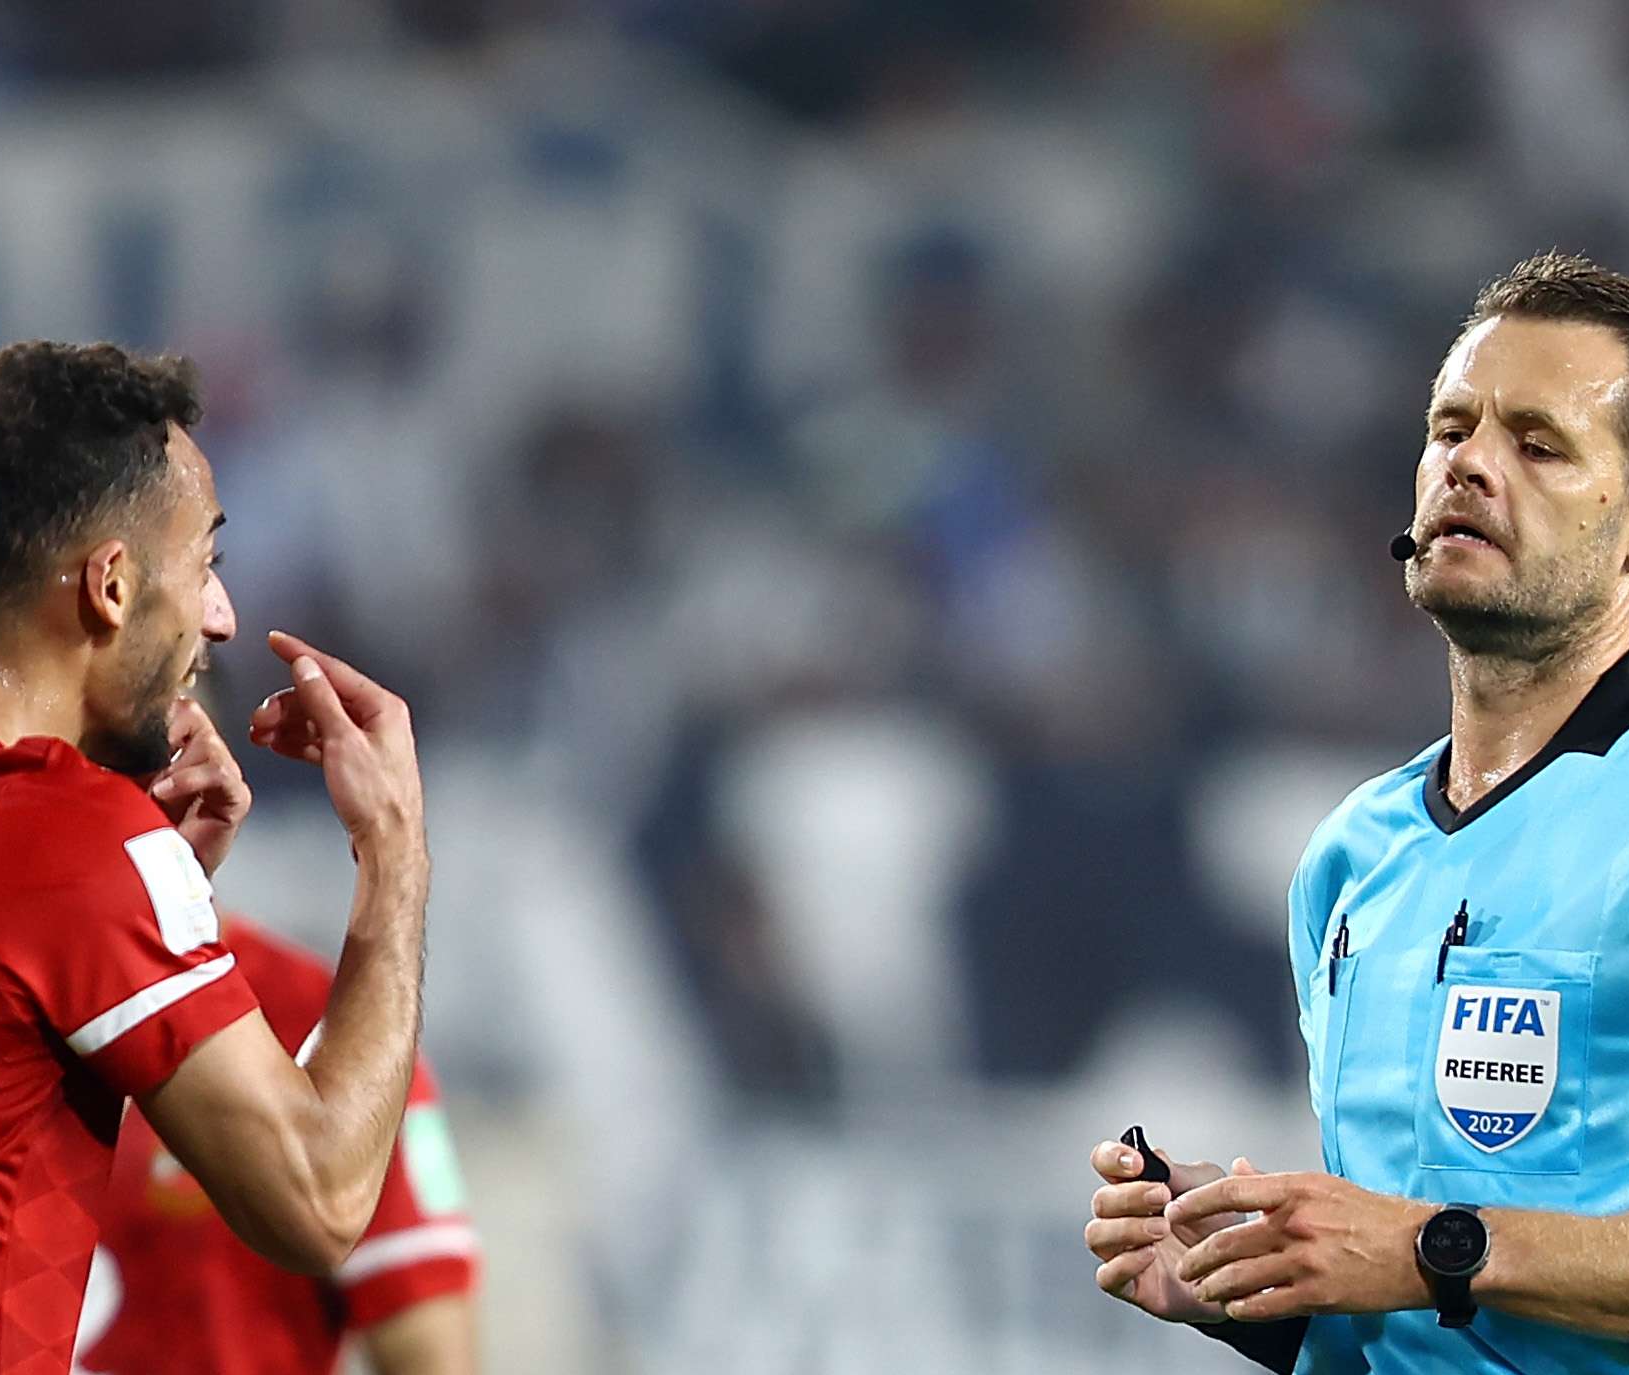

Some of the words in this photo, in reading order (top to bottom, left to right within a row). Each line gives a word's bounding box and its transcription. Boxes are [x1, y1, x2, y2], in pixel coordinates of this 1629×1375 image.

[1452, 995, 1545, 1037] FIFA
[1444, 1058, 1545, 1085] REFEREE
[1467, 1114, 1515, 1135] 2022
